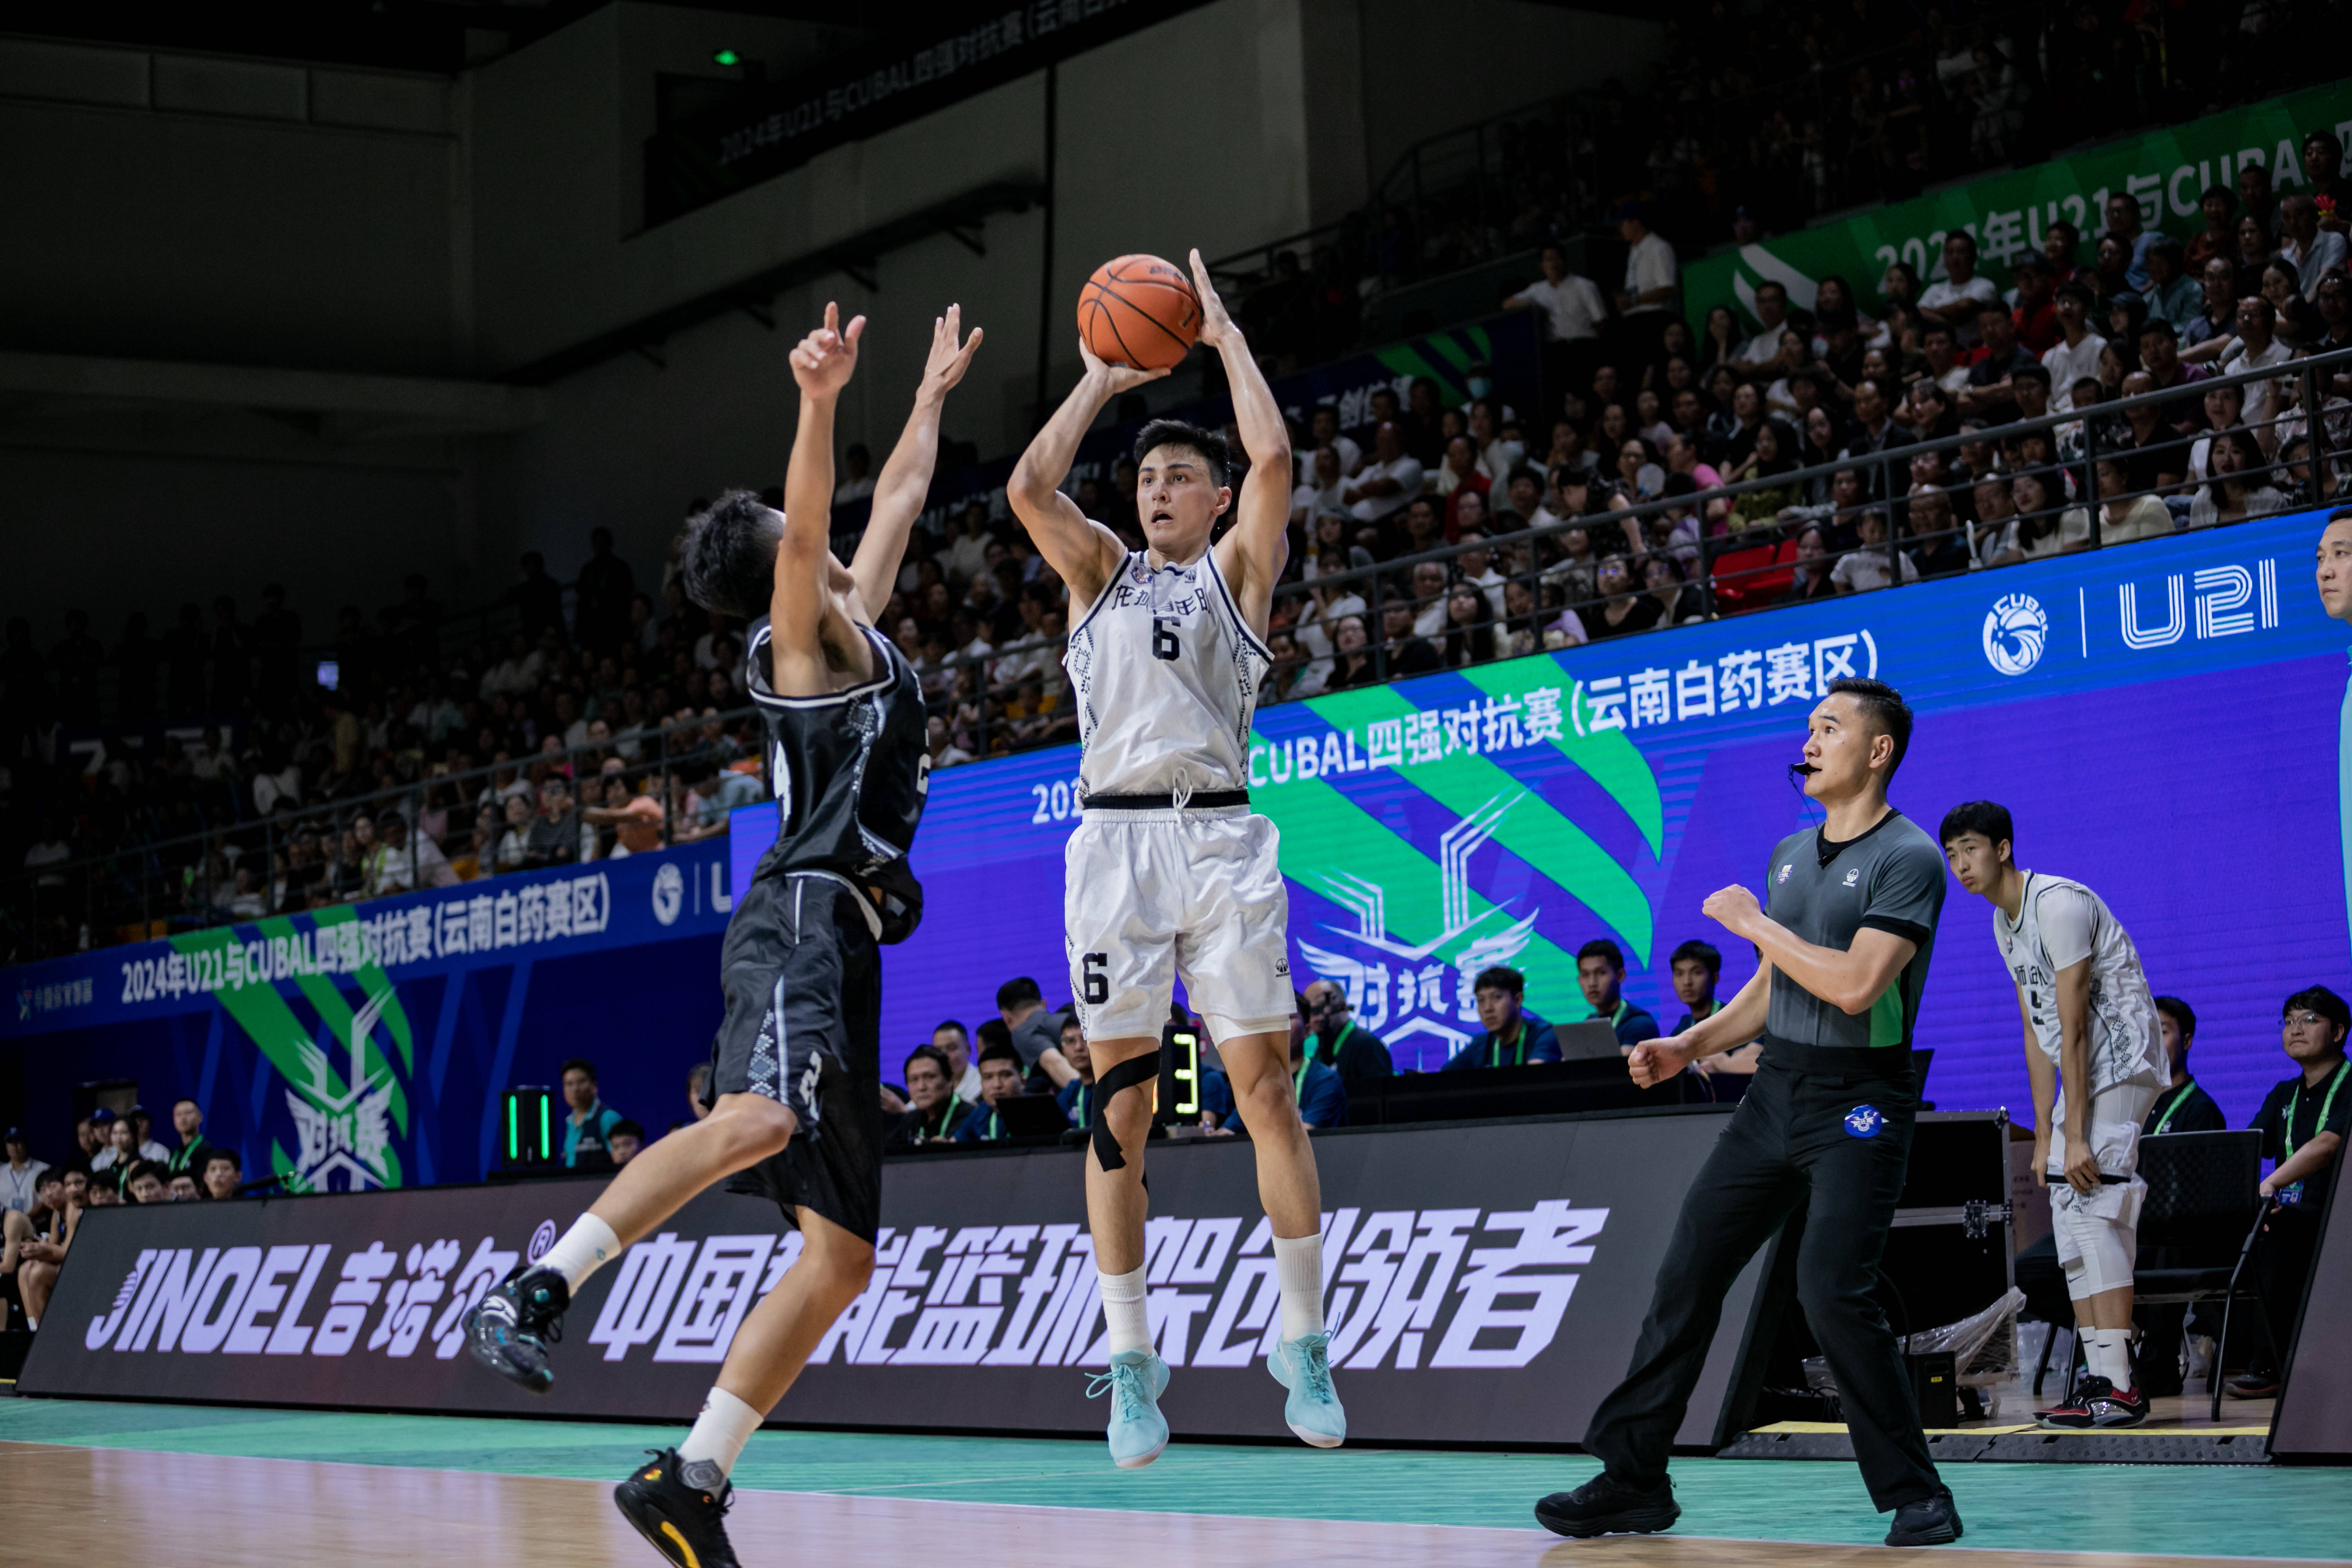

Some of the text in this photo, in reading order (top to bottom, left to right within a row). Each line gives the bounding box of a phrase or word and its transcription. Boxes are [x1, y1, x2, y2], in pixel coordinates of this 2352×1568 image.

[1993, 593, 2049, 643] CUBAL
[2119, 558, 2278, 650] U21
[1152, 616, 1181, 661] 6
[1082, 953, 1109, 1005] 6
[1173, 1033, 1198, 1114] 3
[85, 1243, 332, 1355] JINOEL
[588, 1198, 1610, 1369] 中国能篮球架创领者
